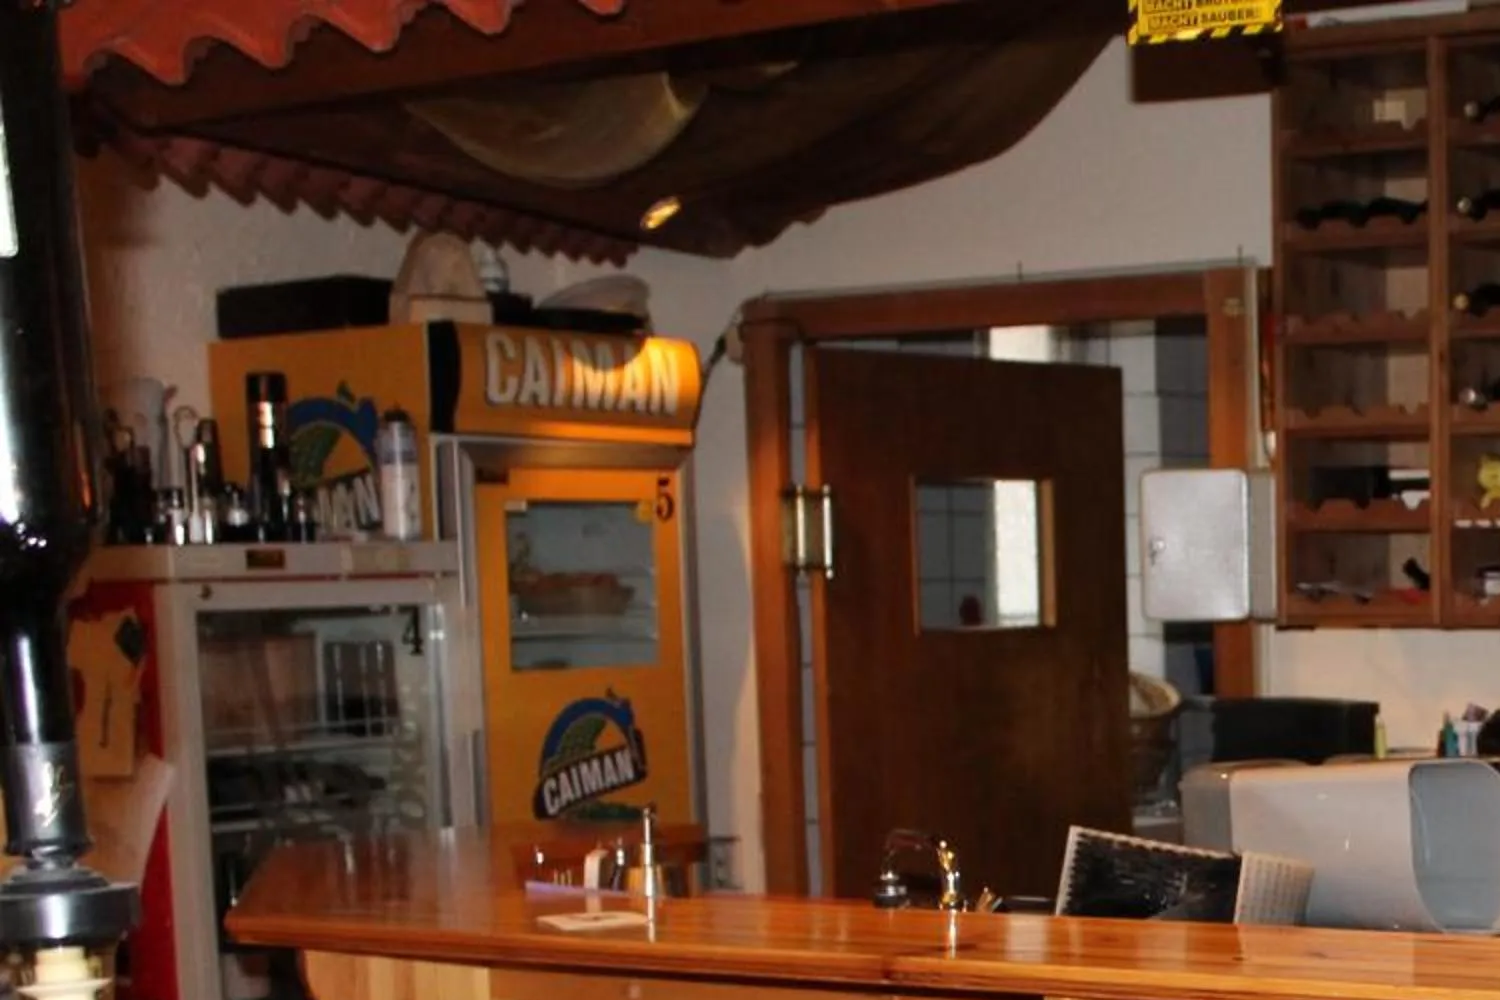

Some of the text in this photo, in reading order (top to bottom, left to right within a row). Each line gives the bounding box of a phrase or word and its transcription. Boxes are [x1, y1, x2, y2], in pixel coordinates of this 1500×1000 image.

[486, 331, 677, 415] CAIMAN
[656, 477, 674, 521] 5
[402, 605, 423, 655] 4
[543, 744, 635, 816] CAIMAN
